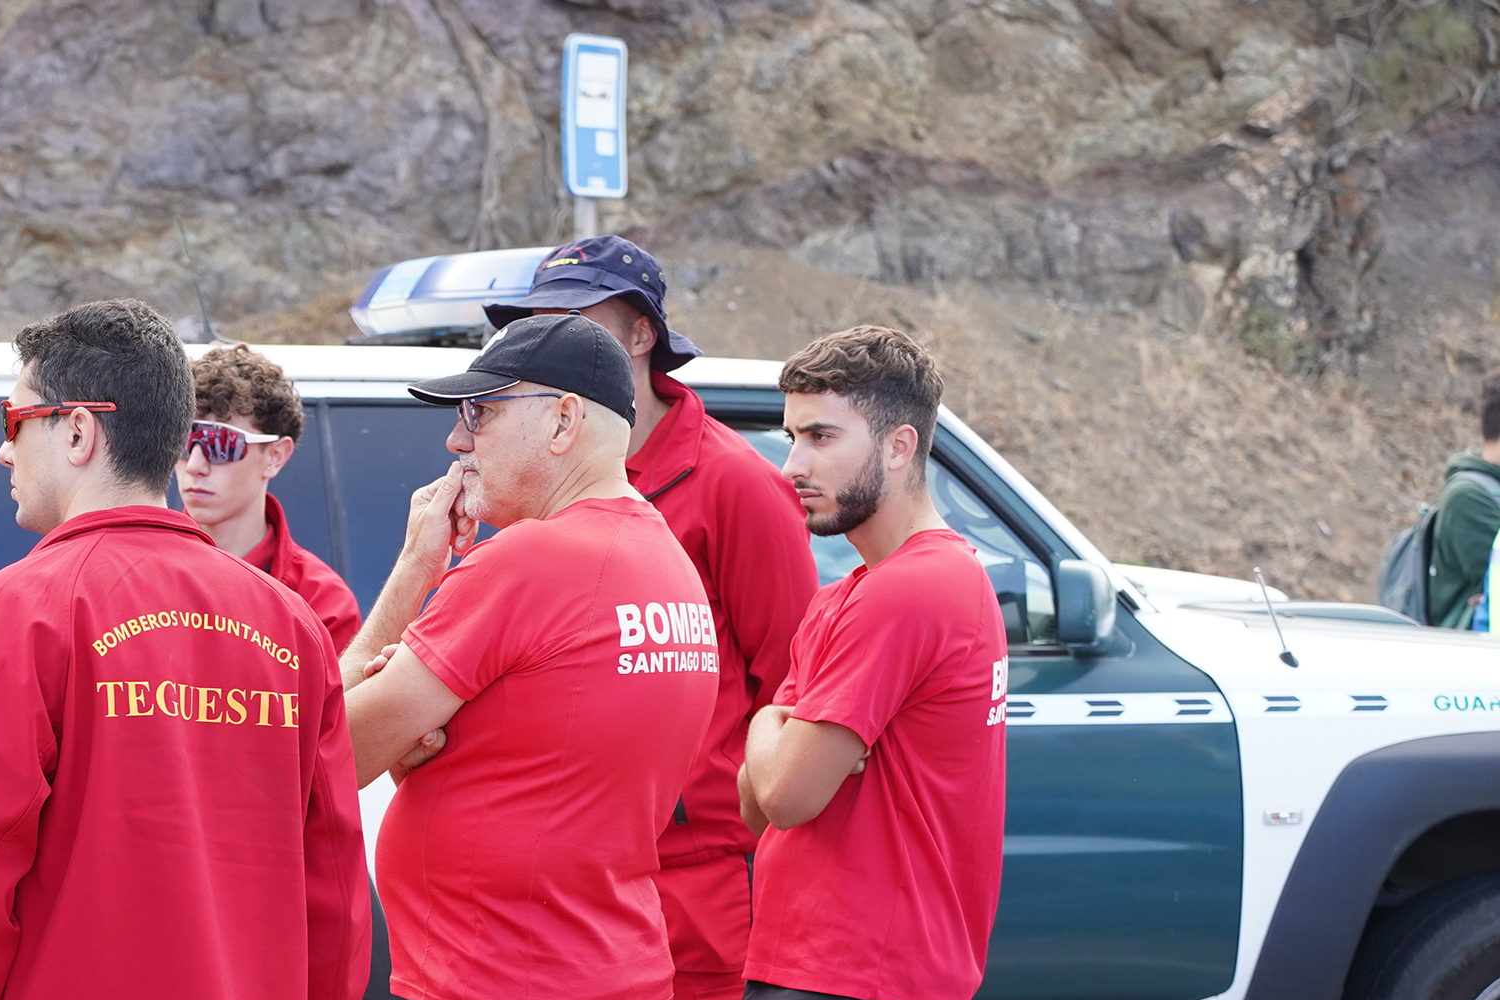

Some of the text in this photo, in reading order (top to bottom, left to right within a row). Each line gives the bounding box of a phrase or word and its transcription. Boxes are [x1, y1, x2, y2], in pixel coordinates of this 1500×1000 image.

[92, 610, 299, 670] BOMBEROS VOLUNTARIOS
[617, 651, 718, 675] SANTIAGO DEL
[96, 680, 299, 728] TEGUESTE
